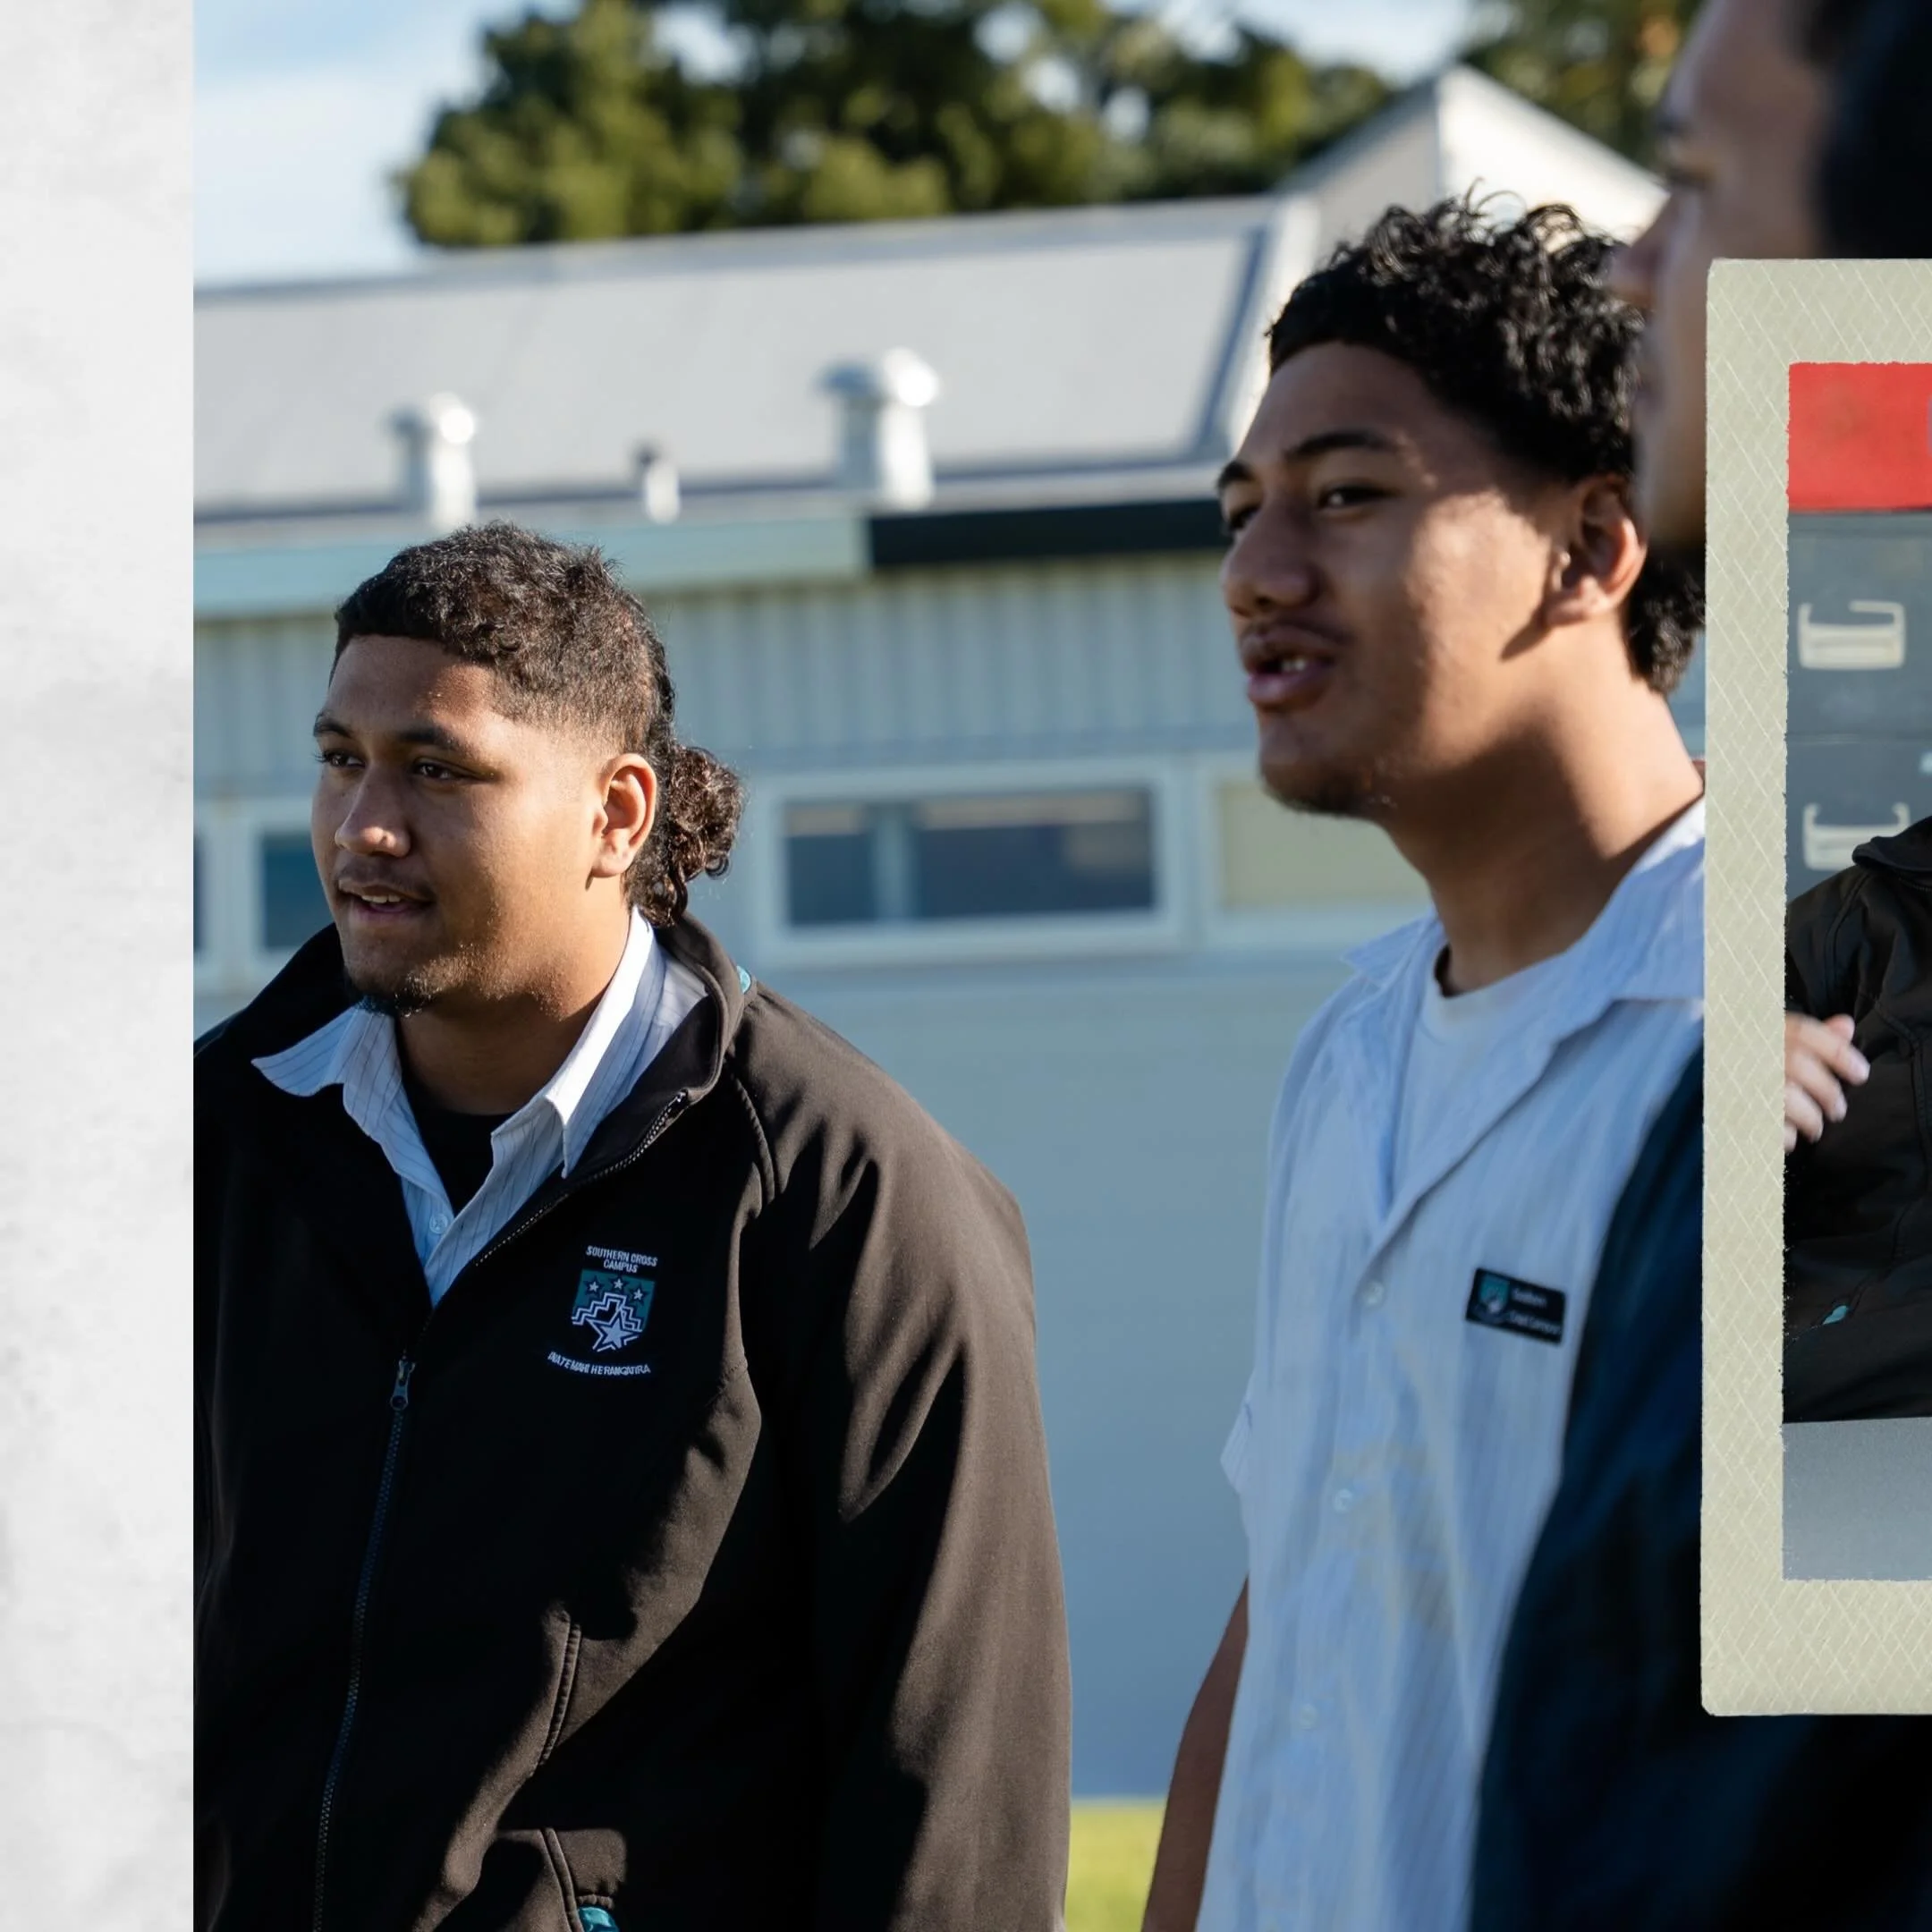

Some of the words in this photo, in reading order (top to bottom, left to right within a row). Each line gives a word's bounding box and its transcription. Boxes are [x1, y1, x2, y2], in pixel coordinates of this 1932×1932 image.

[586, 1245, 630, 1261] SOUTHERN
[631, 1252, 657, 1267] CROSS
[603, 1259, 638, 1273] CAMPUS
[590, 1365, 603, 1375] HE
